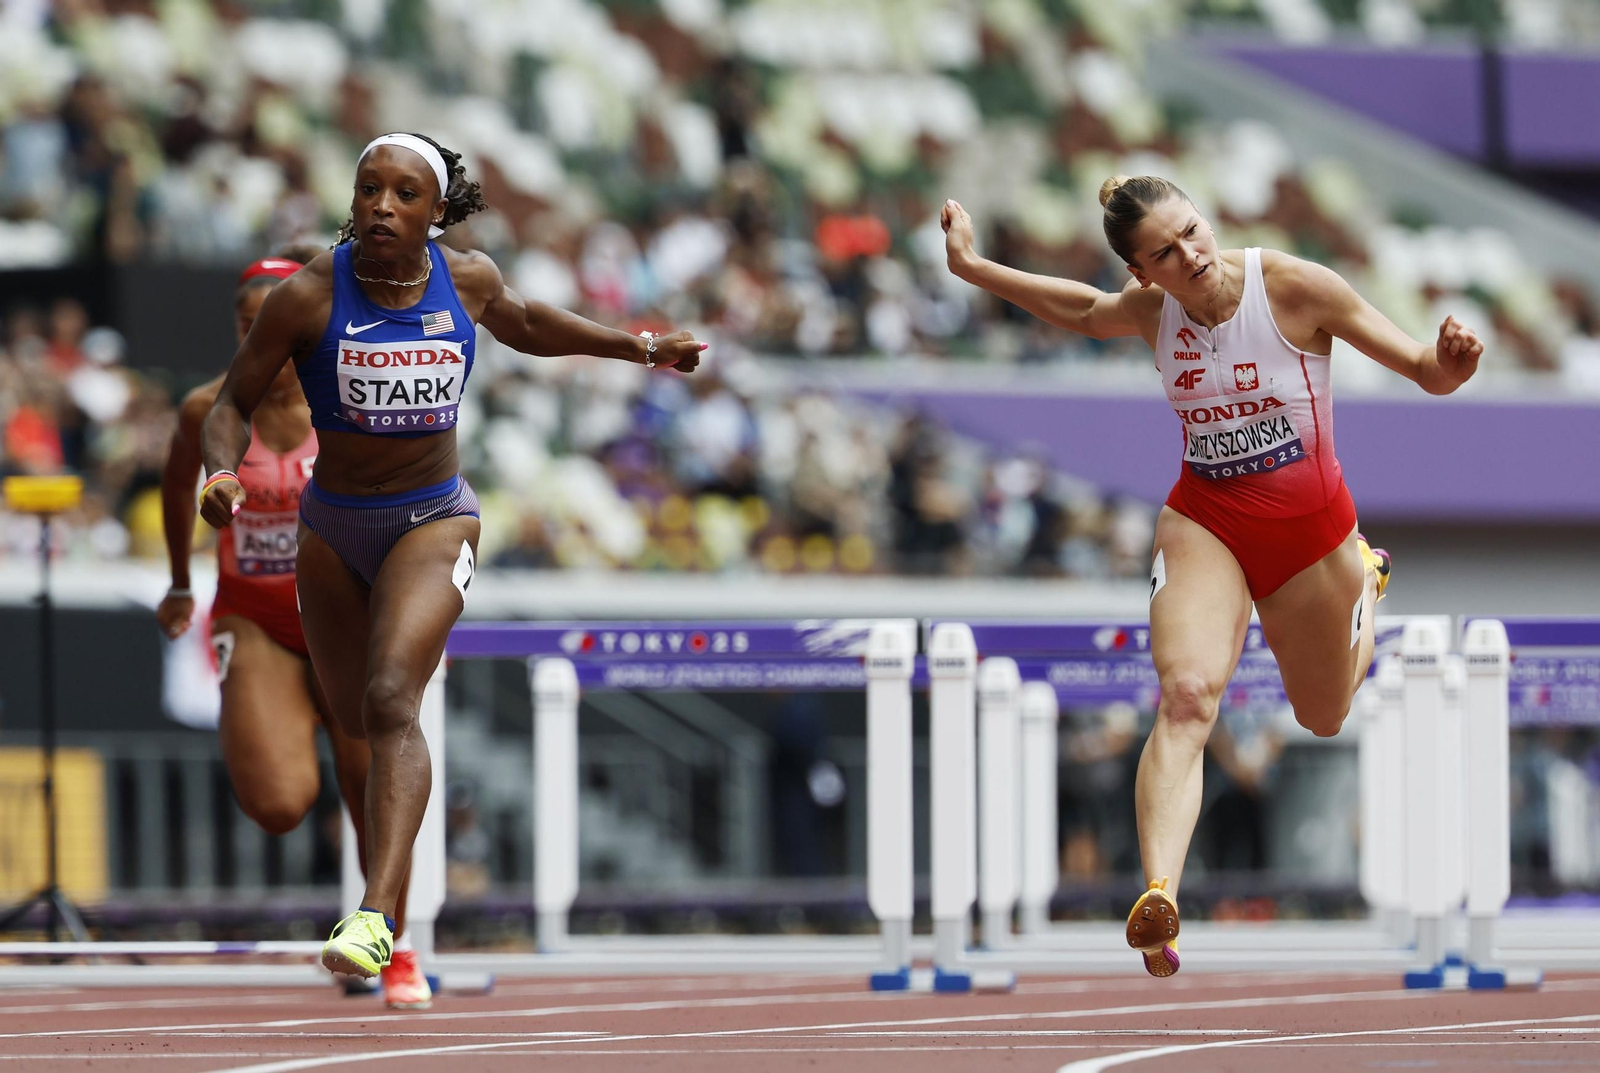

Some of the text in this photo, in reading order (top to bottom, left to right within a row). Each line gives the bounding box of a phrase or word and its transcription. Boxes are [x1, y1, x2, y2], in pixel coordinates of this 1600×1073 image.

[340, 349, 462, 368] HONDA
[1173, 351, 1201, 361] ORLEN
[1174, 368, 1206, 390] 4F
[347, 377, 455, 406] STARK
